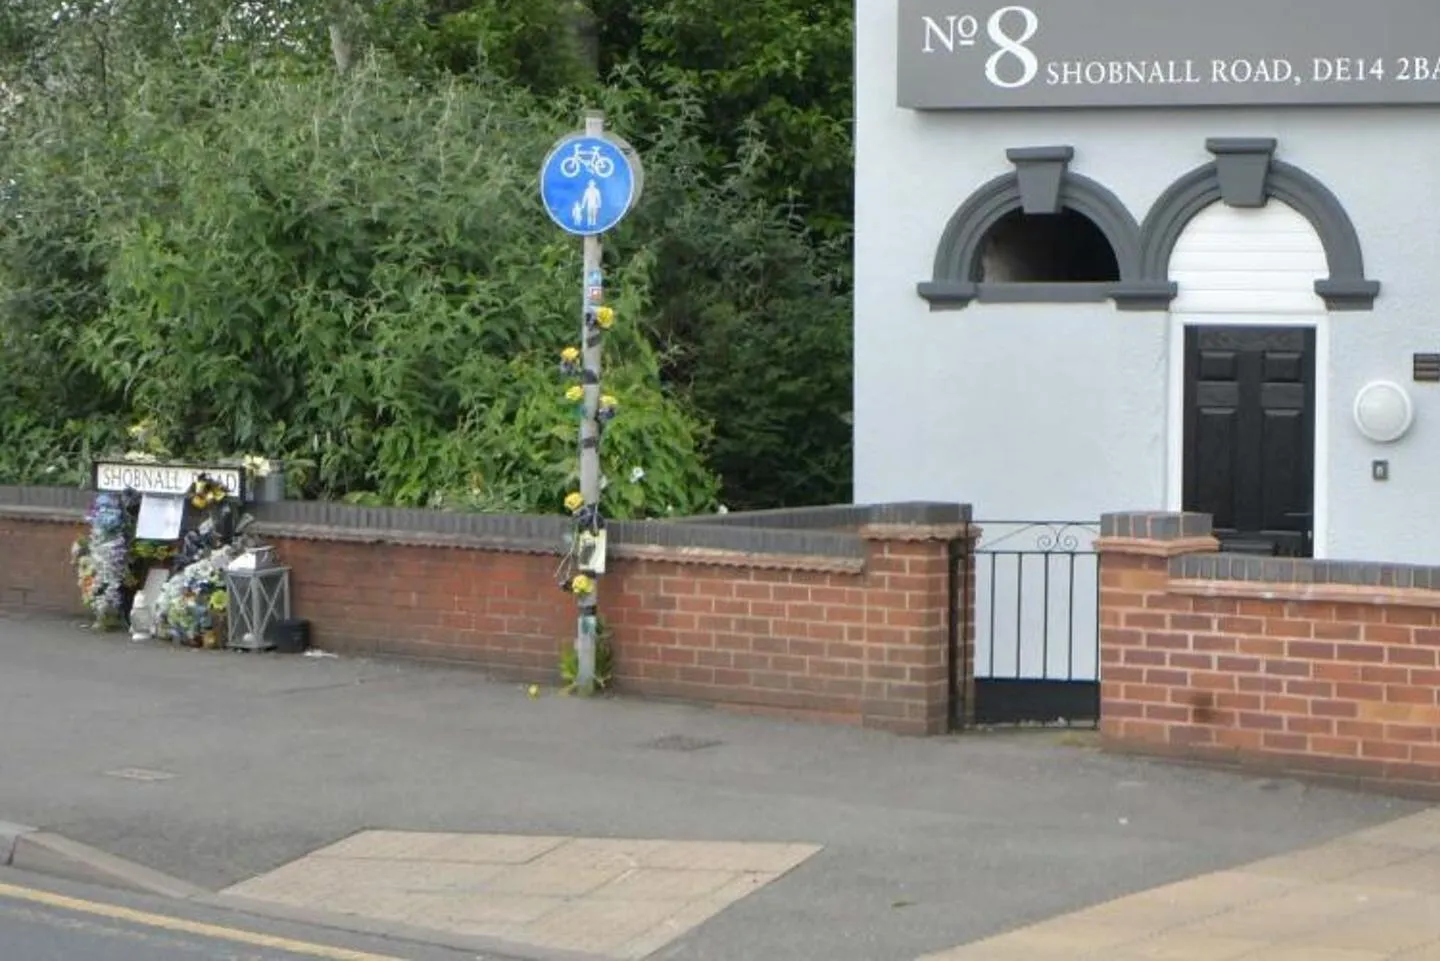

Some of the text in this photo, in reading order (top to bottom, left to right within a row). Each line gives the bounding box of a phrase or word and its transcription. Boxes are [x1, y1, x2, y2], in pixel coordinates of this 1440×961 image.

[985, 5, 1038, 88] 8
[1046, 60, 1200, 85] SHOBNALL
[1211, 58, 1302, 86] ROAD,
[1313, 57, 1384, 81] DE14
[103, 468, 180, 489] SHOBNALL
